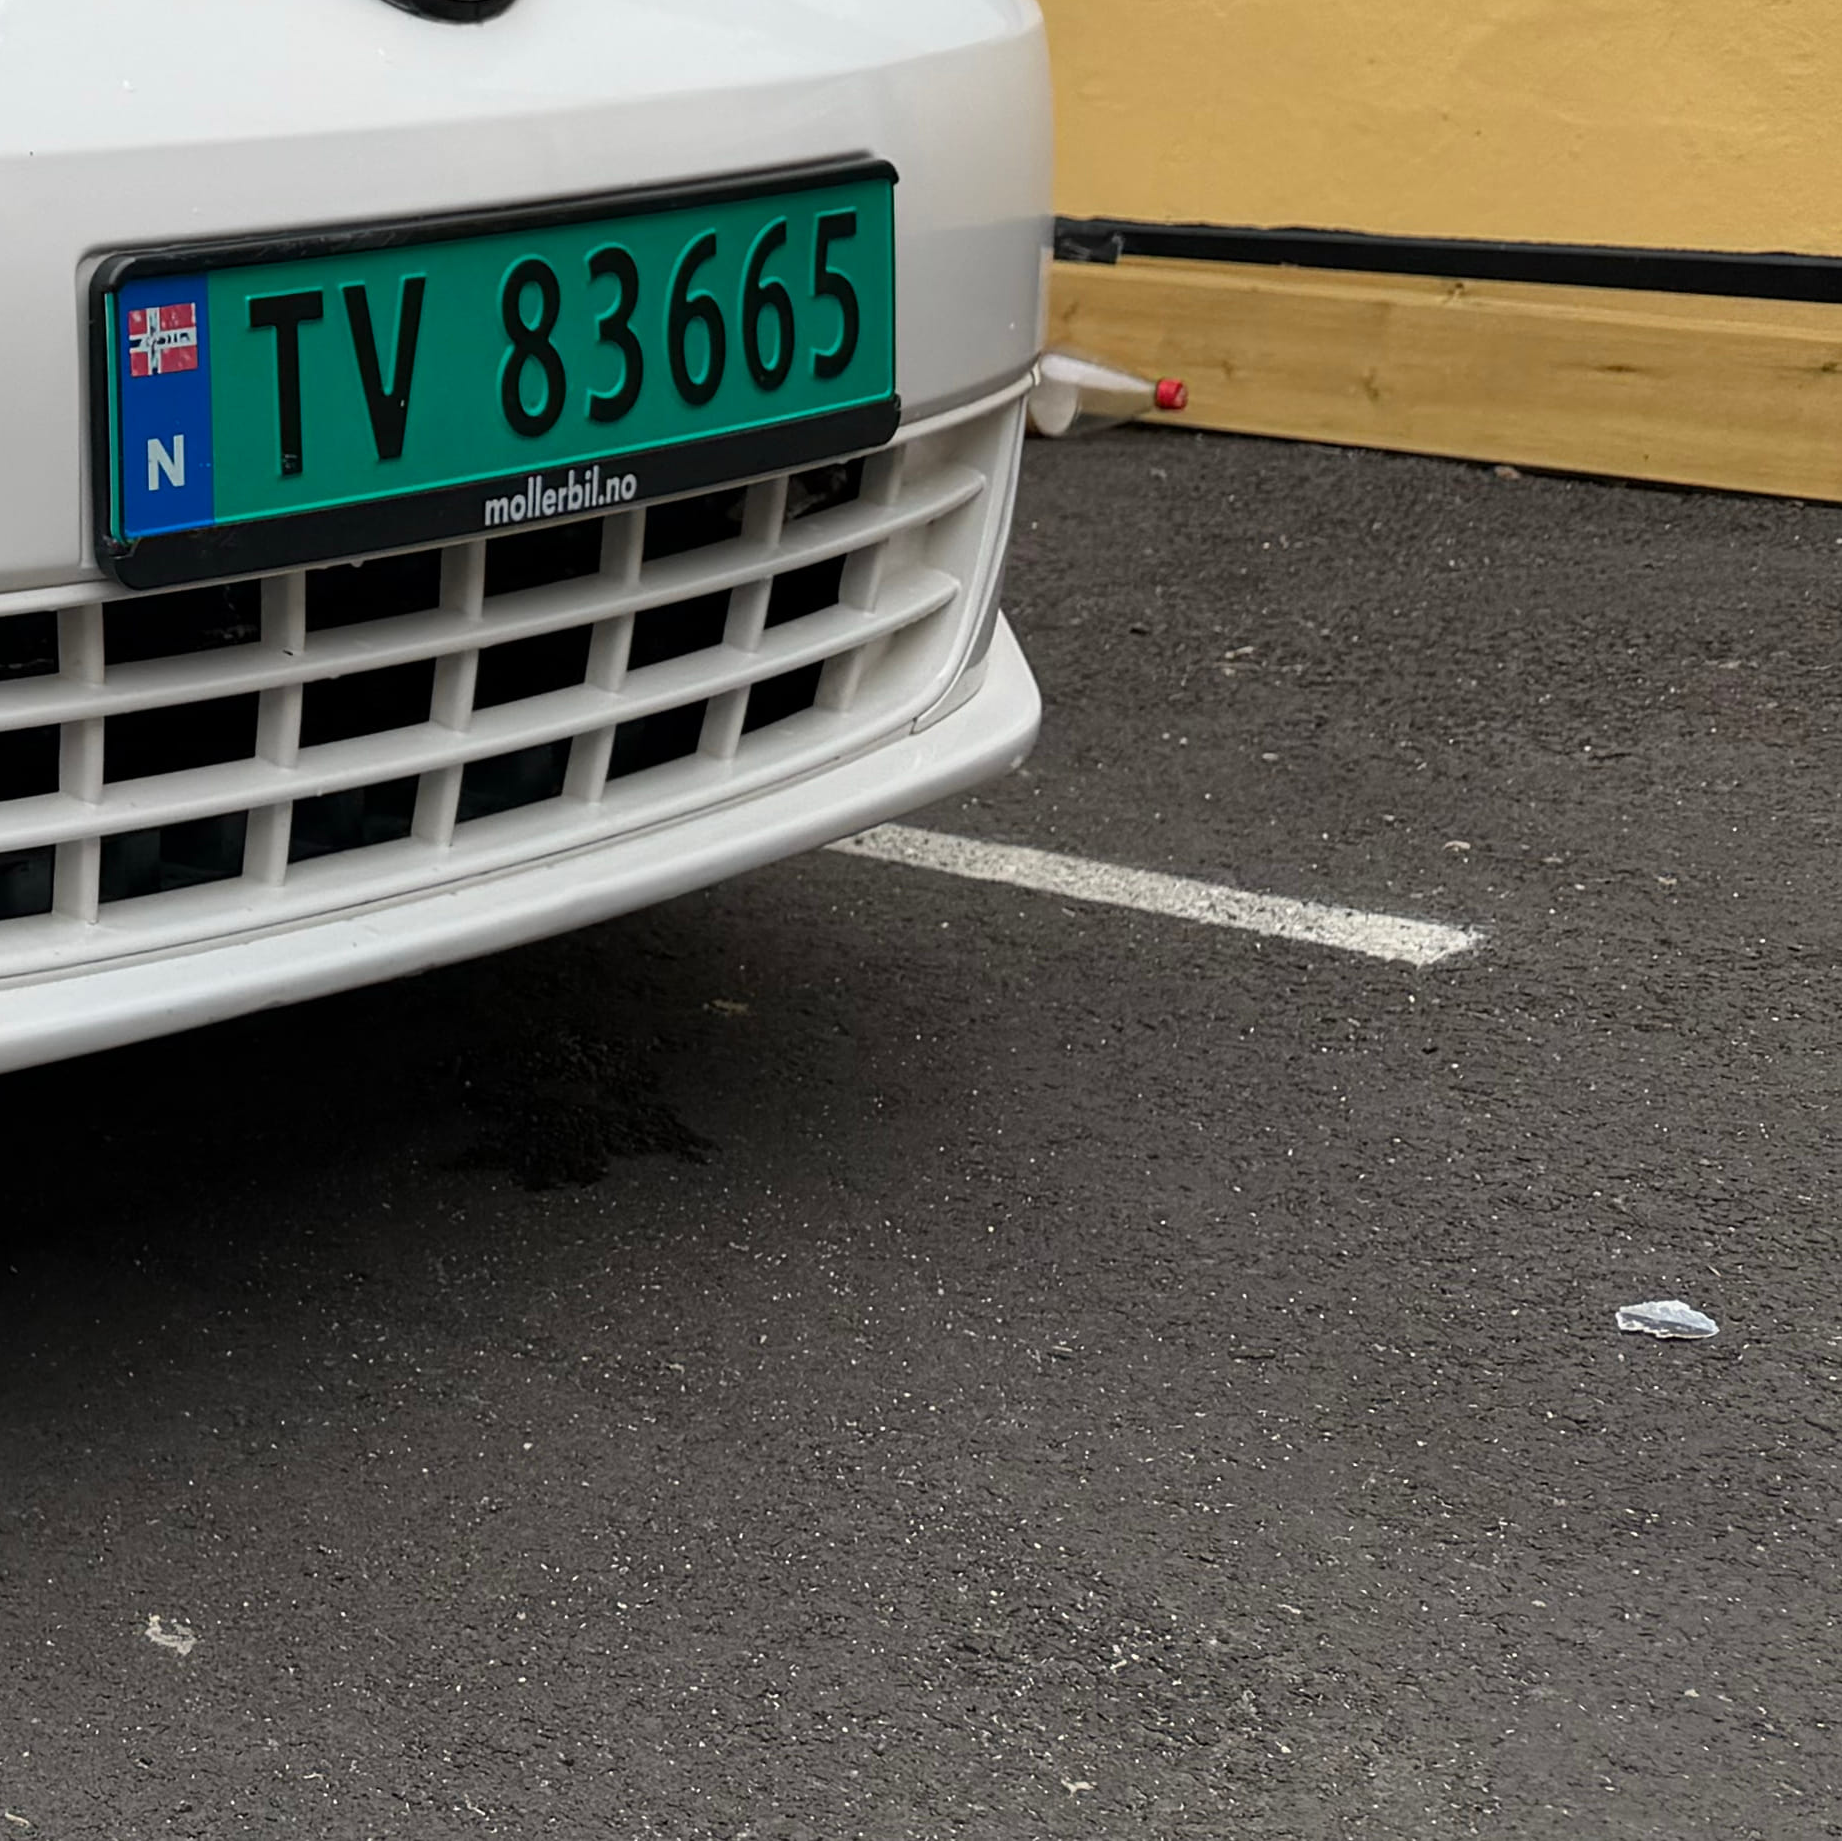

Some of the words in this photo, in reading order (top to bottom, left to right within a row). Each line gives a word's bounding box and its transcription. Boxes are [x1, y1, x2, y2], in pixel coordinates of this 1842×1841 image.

[248, 276, 427, 477] TV
[498, 209, 860, 439] 83665
[147, 434, 186, 492] N
[484, 465, 638, 527] mollerbil.no
